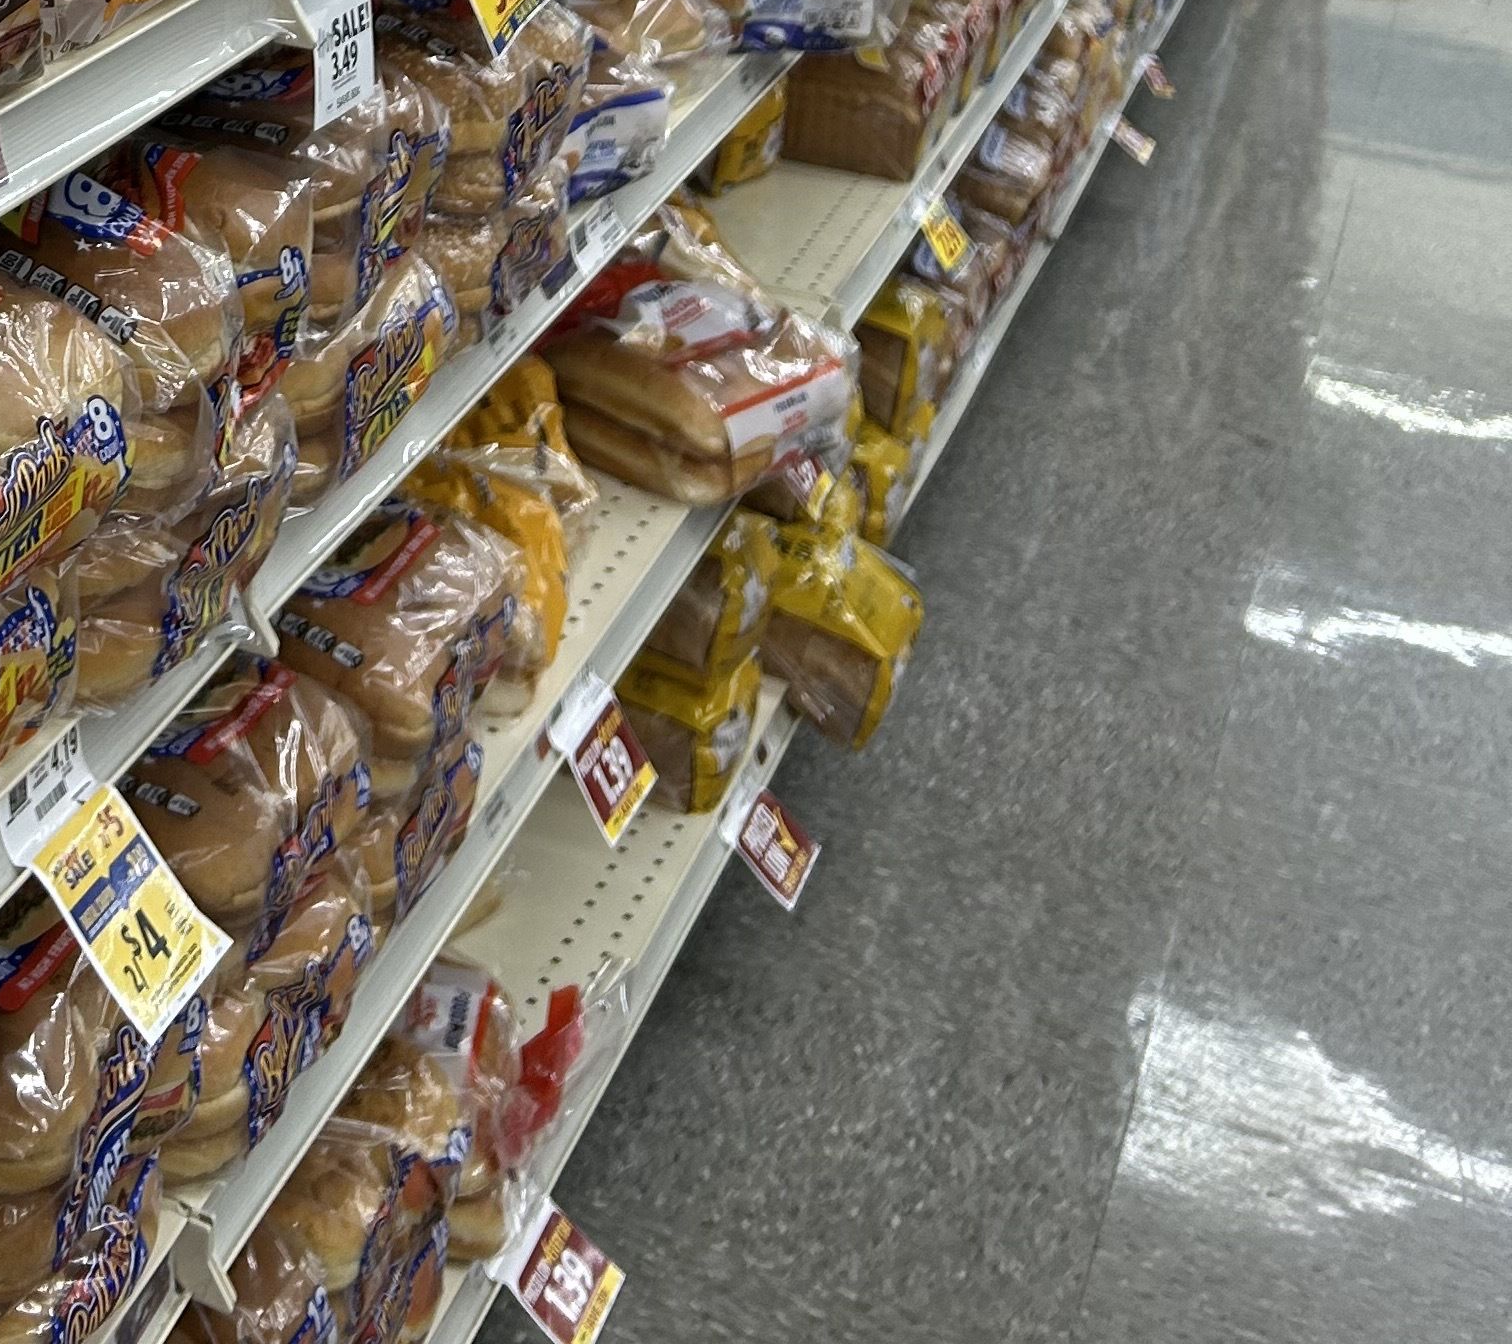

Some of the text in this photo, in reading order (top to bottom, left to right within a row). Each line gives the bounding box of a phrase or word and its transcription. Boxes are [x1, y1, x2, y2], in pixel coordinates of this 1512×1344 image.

[330, 1, 370, 45] SALE!
[329, 41, 360, 82] 3.49
[87, 396, 114, 439] 8
[591, 735, 631, 807] 1.39
[545, 1247, 597, 1324] 1.39
